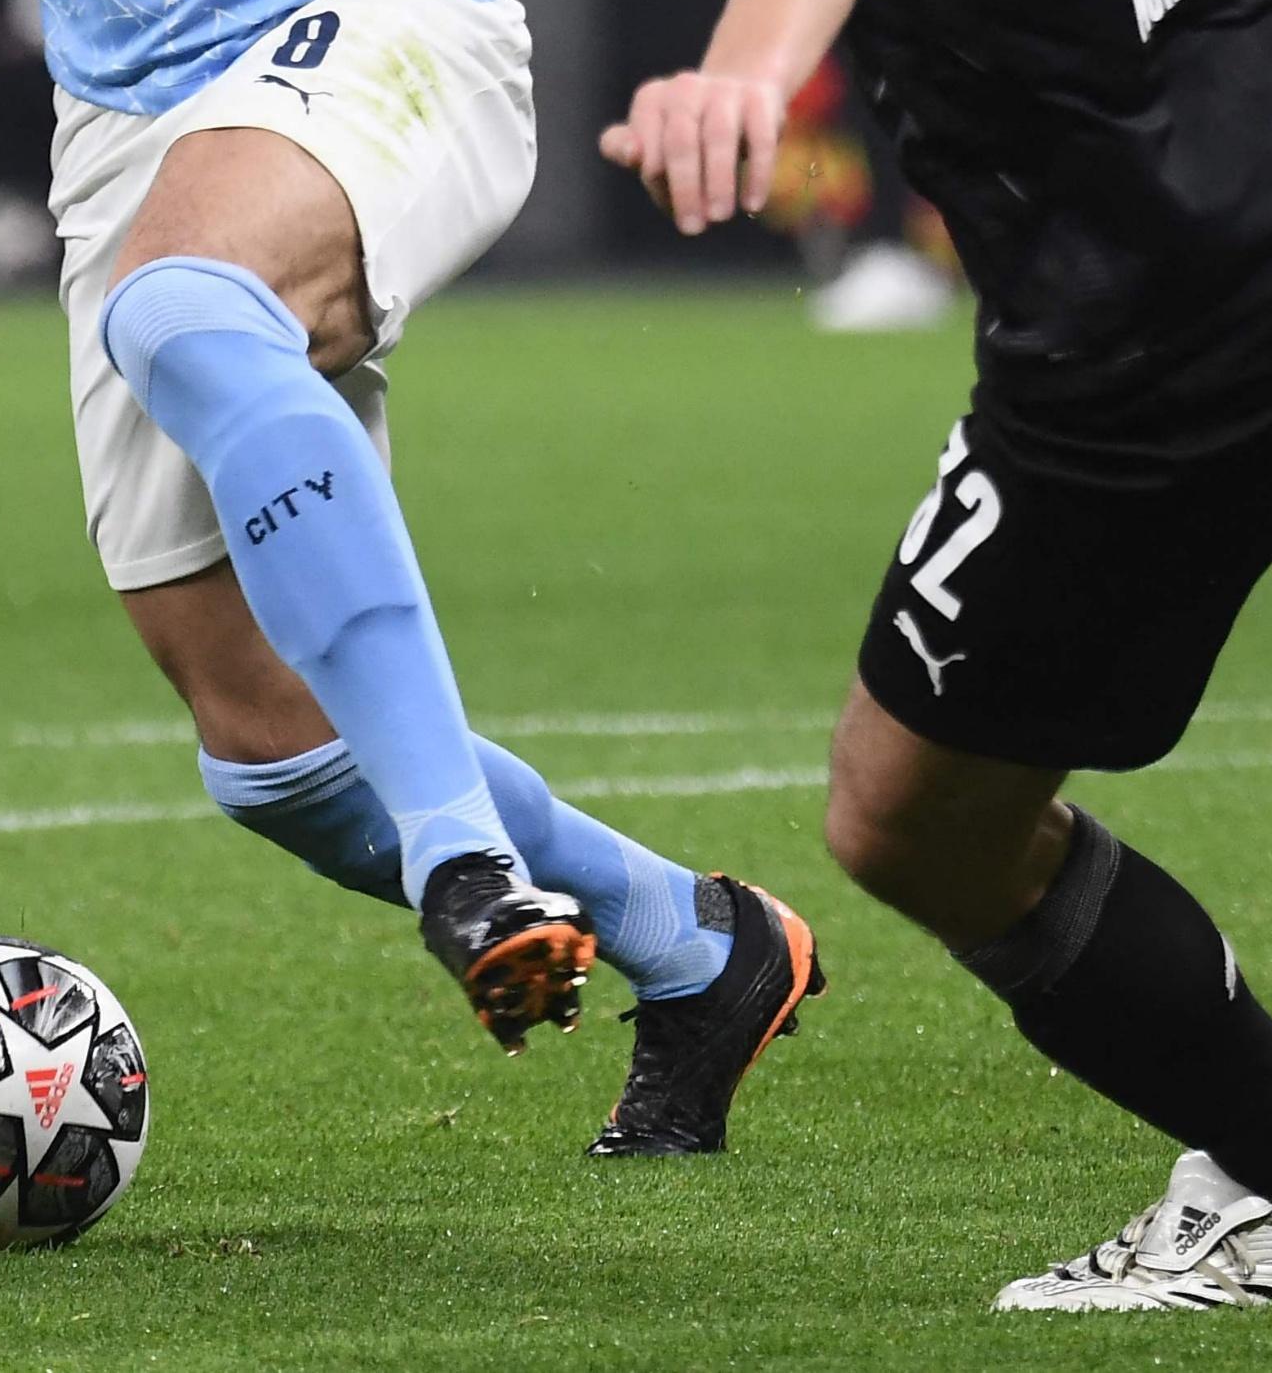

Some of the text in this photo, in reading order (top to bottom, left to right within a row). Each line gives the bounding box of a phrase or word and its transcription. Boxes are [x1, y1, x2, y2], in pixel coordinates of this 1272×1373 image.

[271, 10, 341, 69] 8
[244, 470, 334, 546] CITY
[1175, 1212, 1221, 1256] adidas
